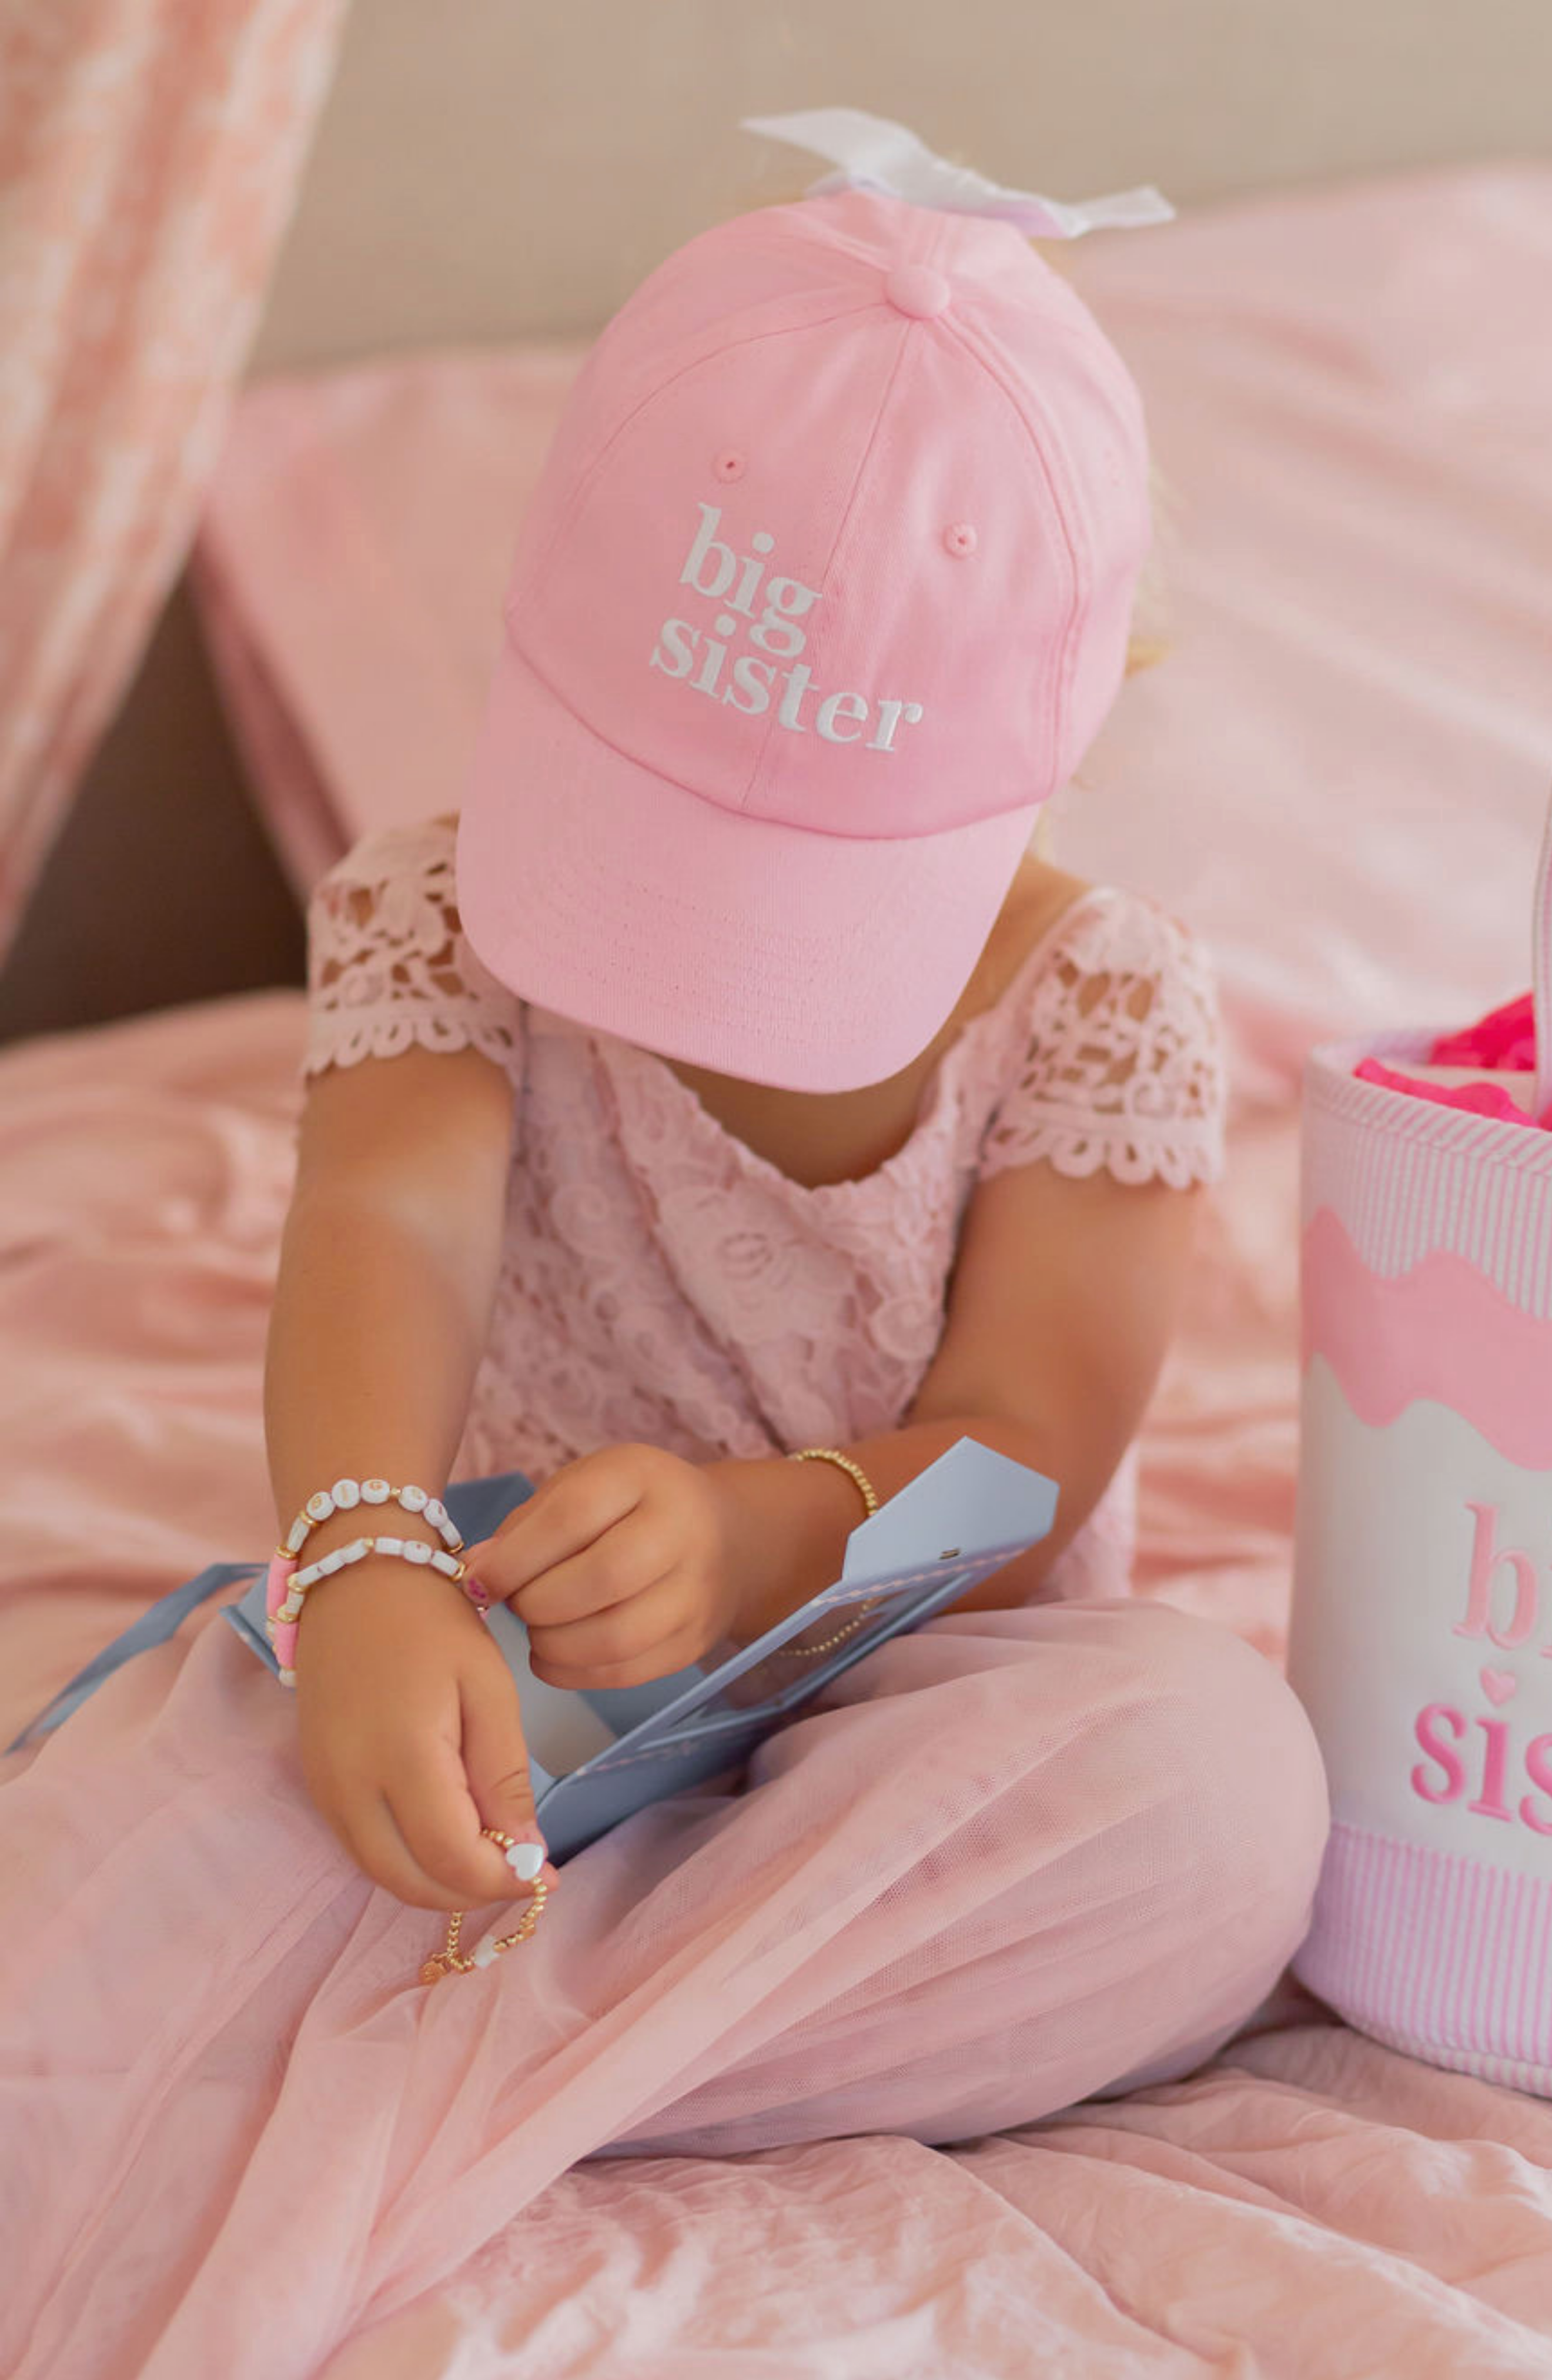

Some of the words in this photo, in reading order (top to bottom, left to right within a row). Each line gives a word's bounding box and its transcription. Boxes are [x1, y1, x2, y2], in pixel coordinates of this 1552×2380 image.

[679, 502, 823, 658] big
[649, 614, 924, 752] sister
[1452, 1499, 1552, 1660] b
